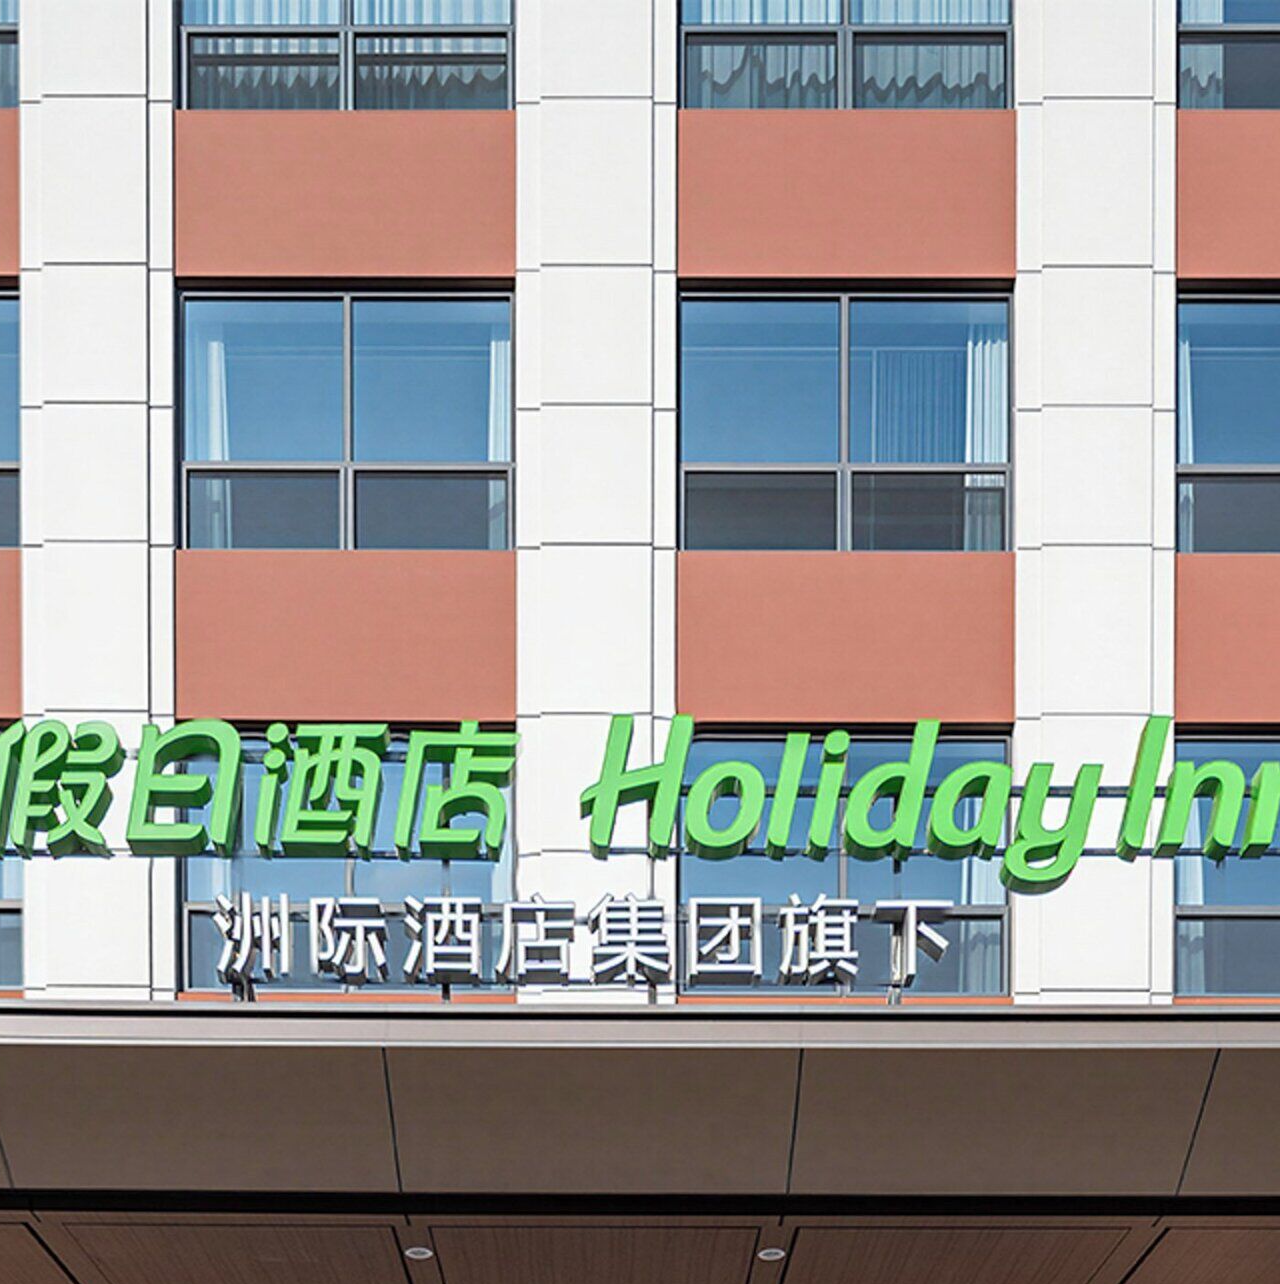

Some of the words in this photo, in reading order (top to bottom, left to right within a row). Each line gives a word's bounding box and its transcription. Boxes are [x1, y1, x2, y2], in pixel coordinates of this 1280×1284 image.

[581, 715, 1103, 895] Holiday
[213, 893, 954, 986] 洲际酒店集团旗下
